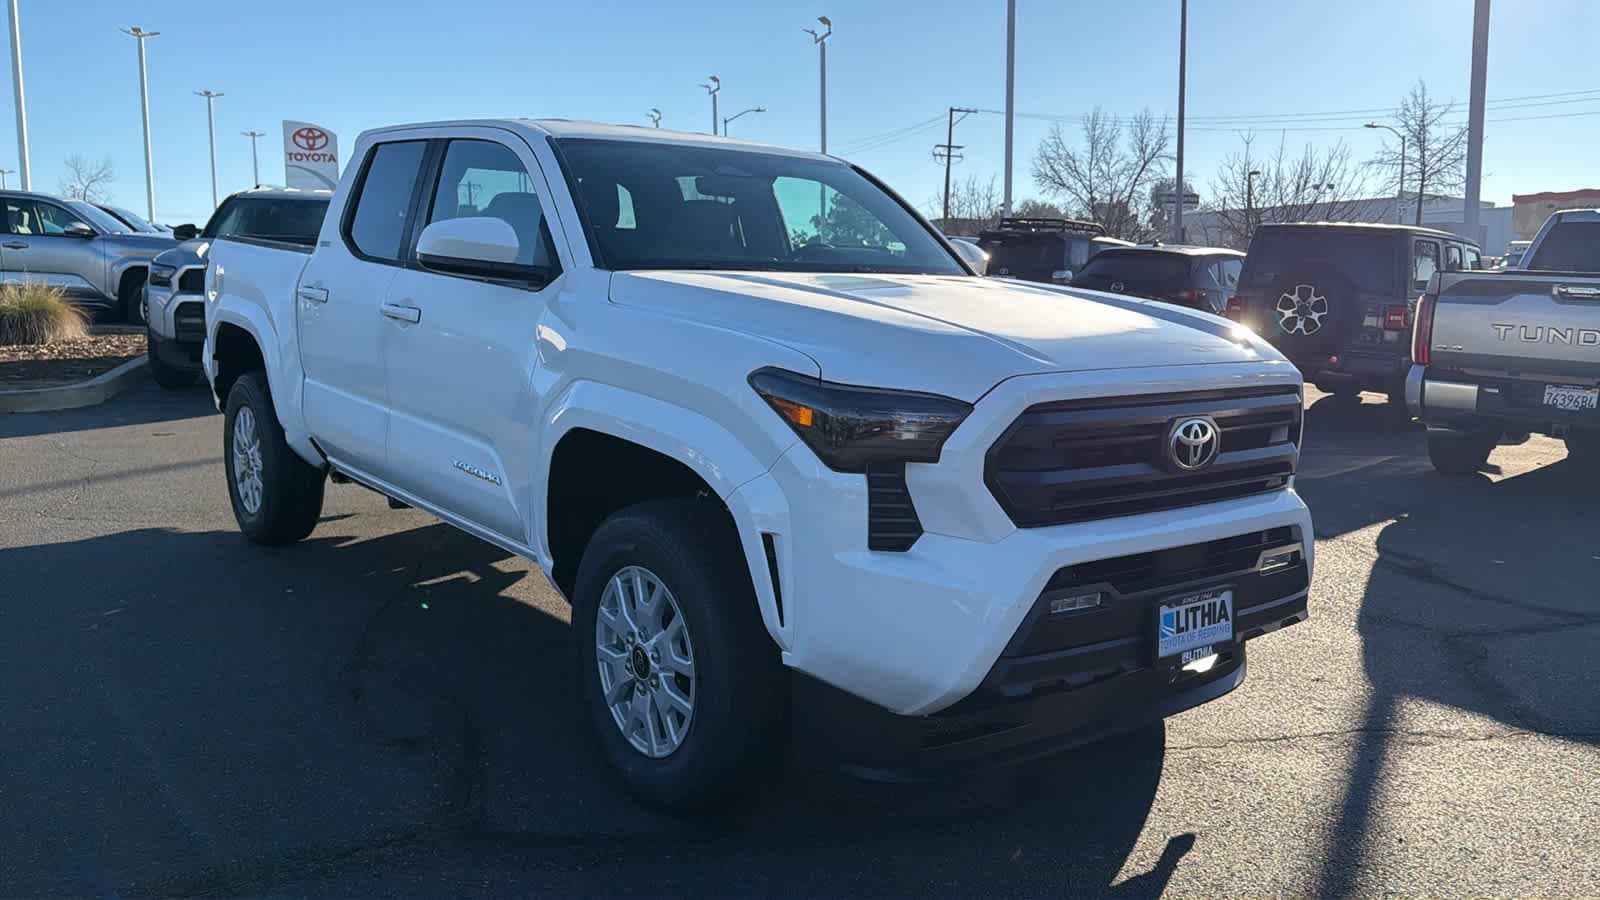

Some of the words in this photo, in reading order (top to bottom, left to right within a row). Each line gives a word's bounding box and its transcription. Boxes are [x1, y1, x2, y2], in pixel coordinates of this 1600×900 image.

[287, 152, 337, 162] TOYOTA
[1491, 323, 1600, 346] TUND
[1176, 600, 1230, 634] LITHIA
